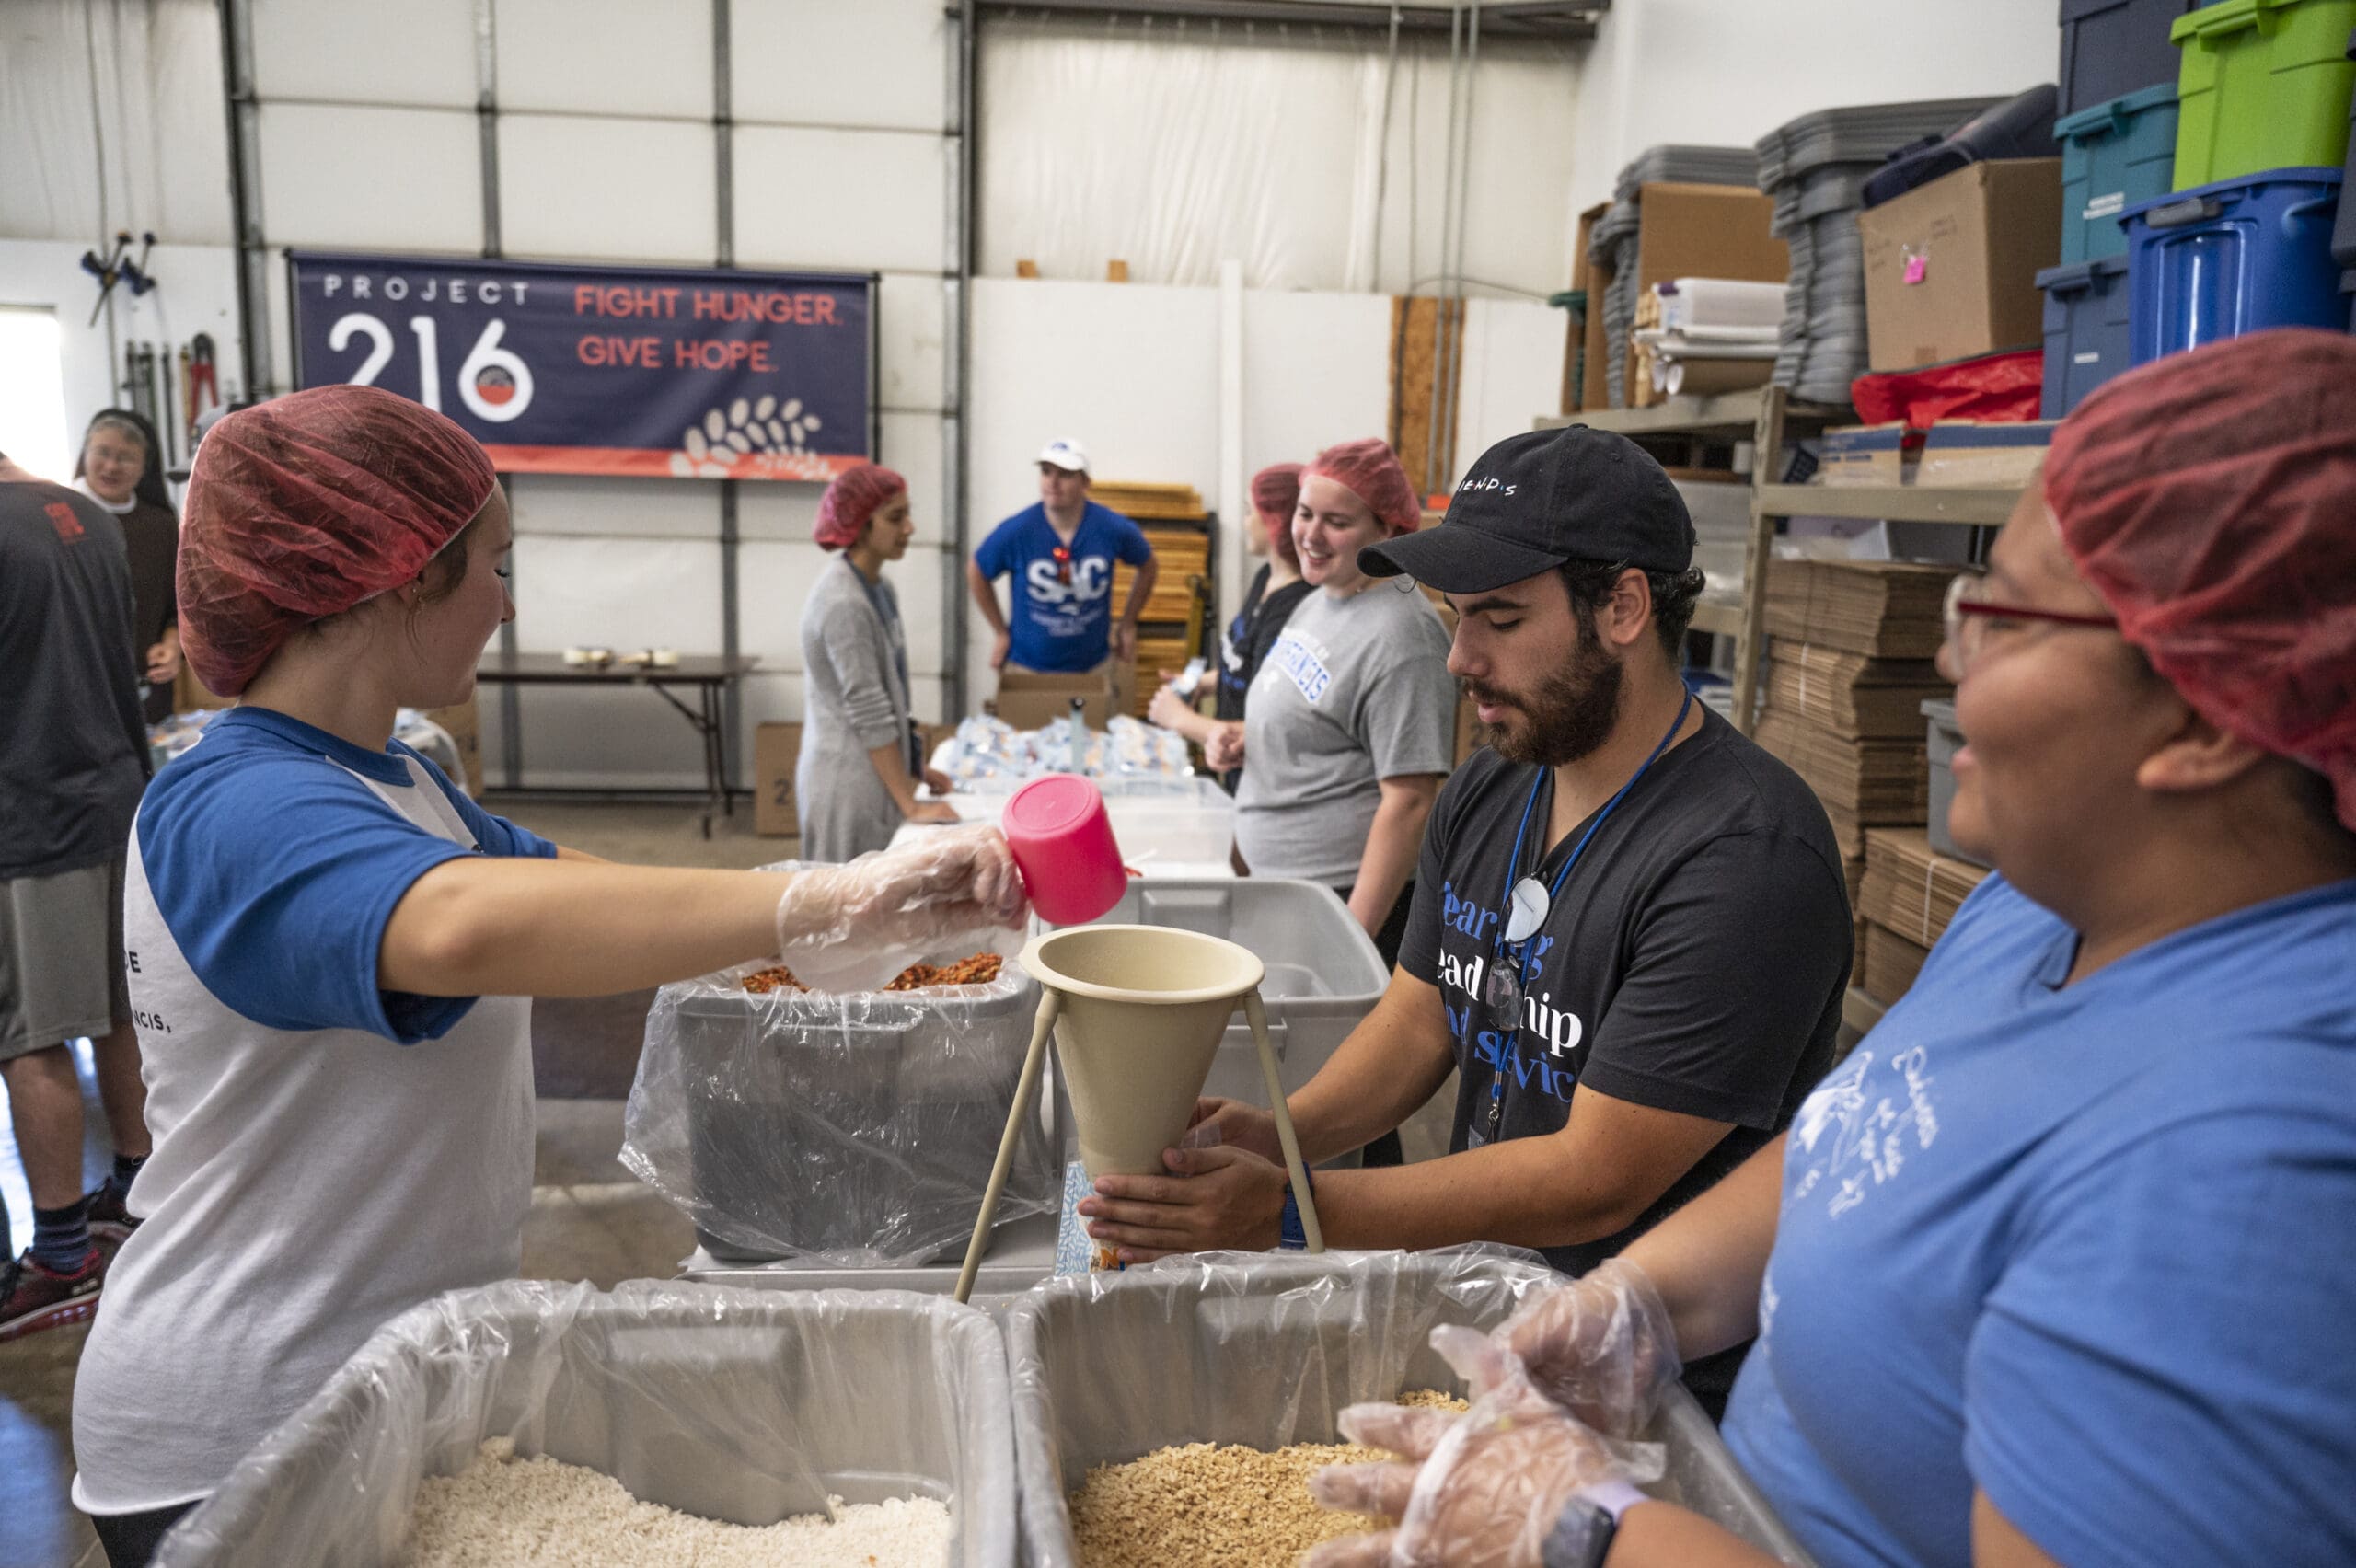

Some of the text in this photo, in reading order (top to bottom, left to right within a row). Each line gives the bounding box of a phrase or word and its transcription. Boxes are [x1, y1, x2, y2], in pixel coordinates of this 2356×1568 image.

[324, 274, 529, 305] PROJECT
[574, 284, 844, 326] FIGHT HUNGER.
[329, 312, 534, 423] 216
[577, 334, 779, 373] GIVE HOPE.
